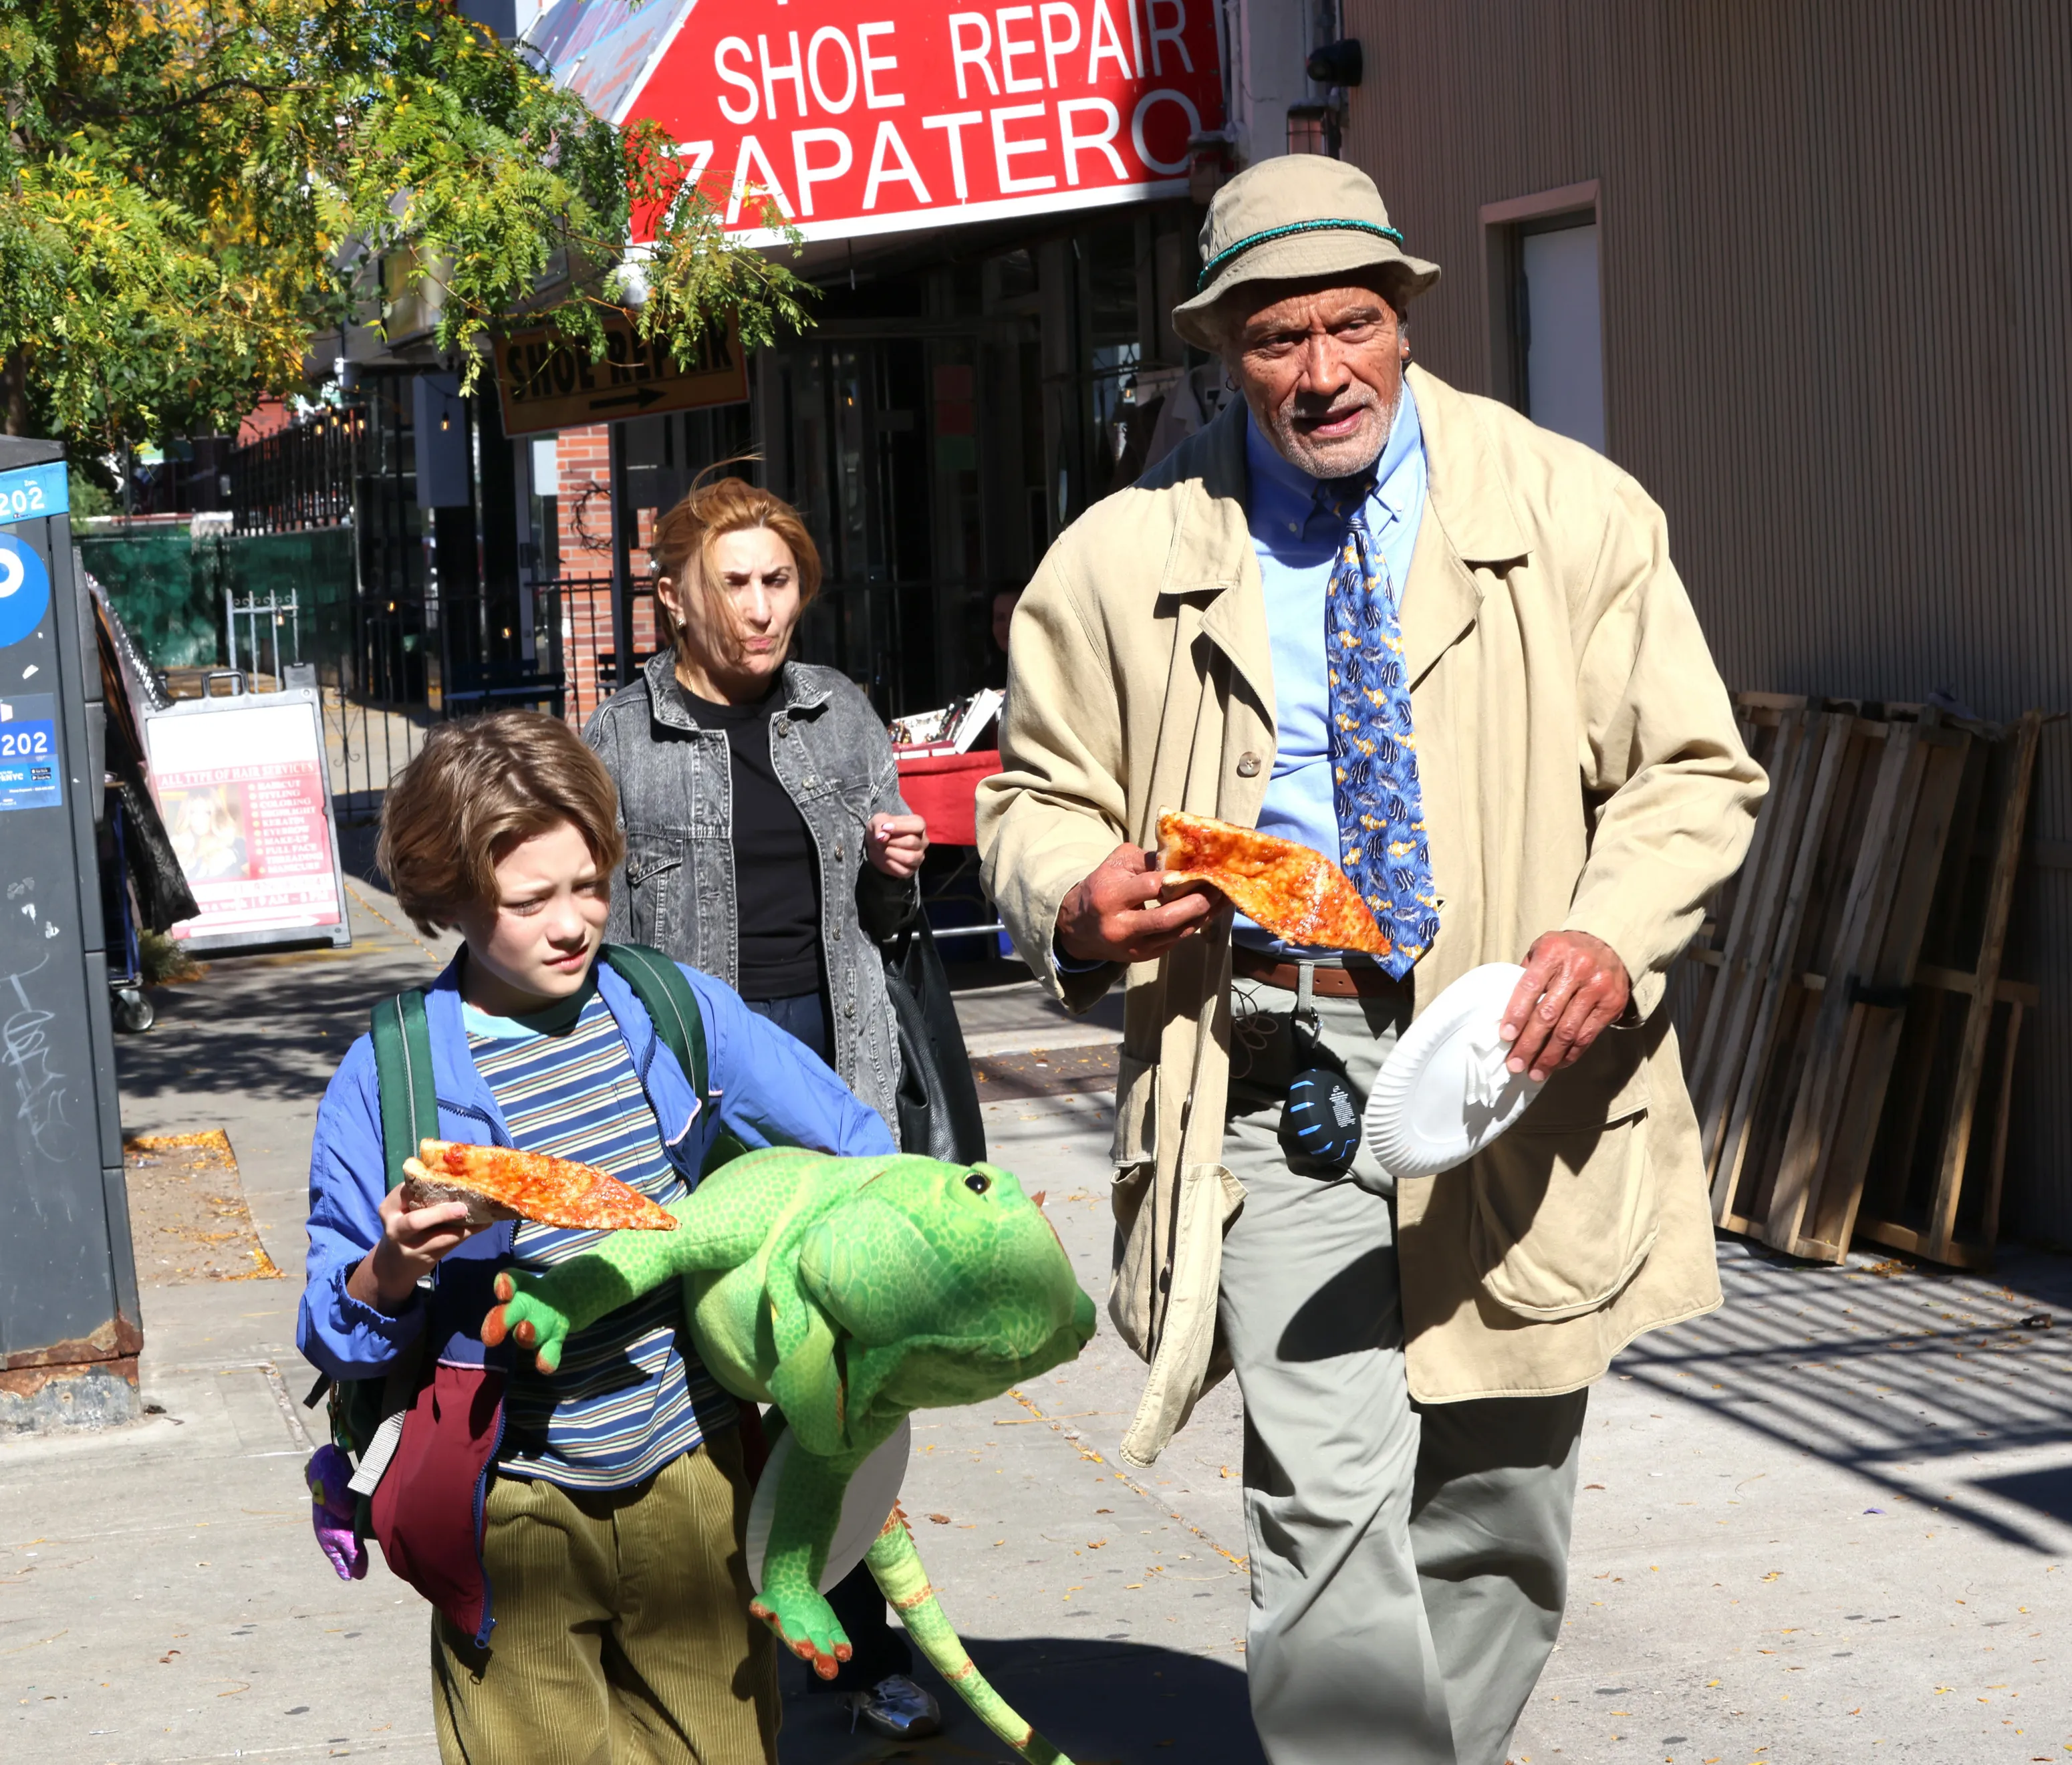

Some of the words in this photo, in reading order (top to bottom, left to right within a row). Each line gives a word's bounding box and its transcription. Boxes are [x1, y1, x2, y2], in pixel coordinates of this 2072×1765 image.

[715, 21, 905, 125] SHOE
[948, 0, 1195, 100] REPAIR
[659, 89, 1202, 232] ZAPATERO
[507, 335, 595, 400] SHOE
[606, 315, 733, 384] REPIR
[0, 487, 45, 516] 202
[1, 732, 47, 756] 202
[0, 773, 23, 781] kNYC
[161, 774, 182, 787] ALL
[184, 771, 213, 783] TYPE
[215, 769, 229, 781] OF
[233, 767, 260, 779] HAIR
[262, 762, 313, 777] SERVICES
[257, 780, 300, 791] HAIRCUT
[258, 789, 300, 800] STYLING
[259, 797, 311, 809] COLORING
[261, 806, 316, 817] HIGHLIGHT
[263, 817, 305, 827] KERATIN
[265, 835, 309, 845] MAKE-UP
[266, 845, 290, 855] FULL
[292, 843, 317, 852] FACE
[269, 894, 289, 905] AM
